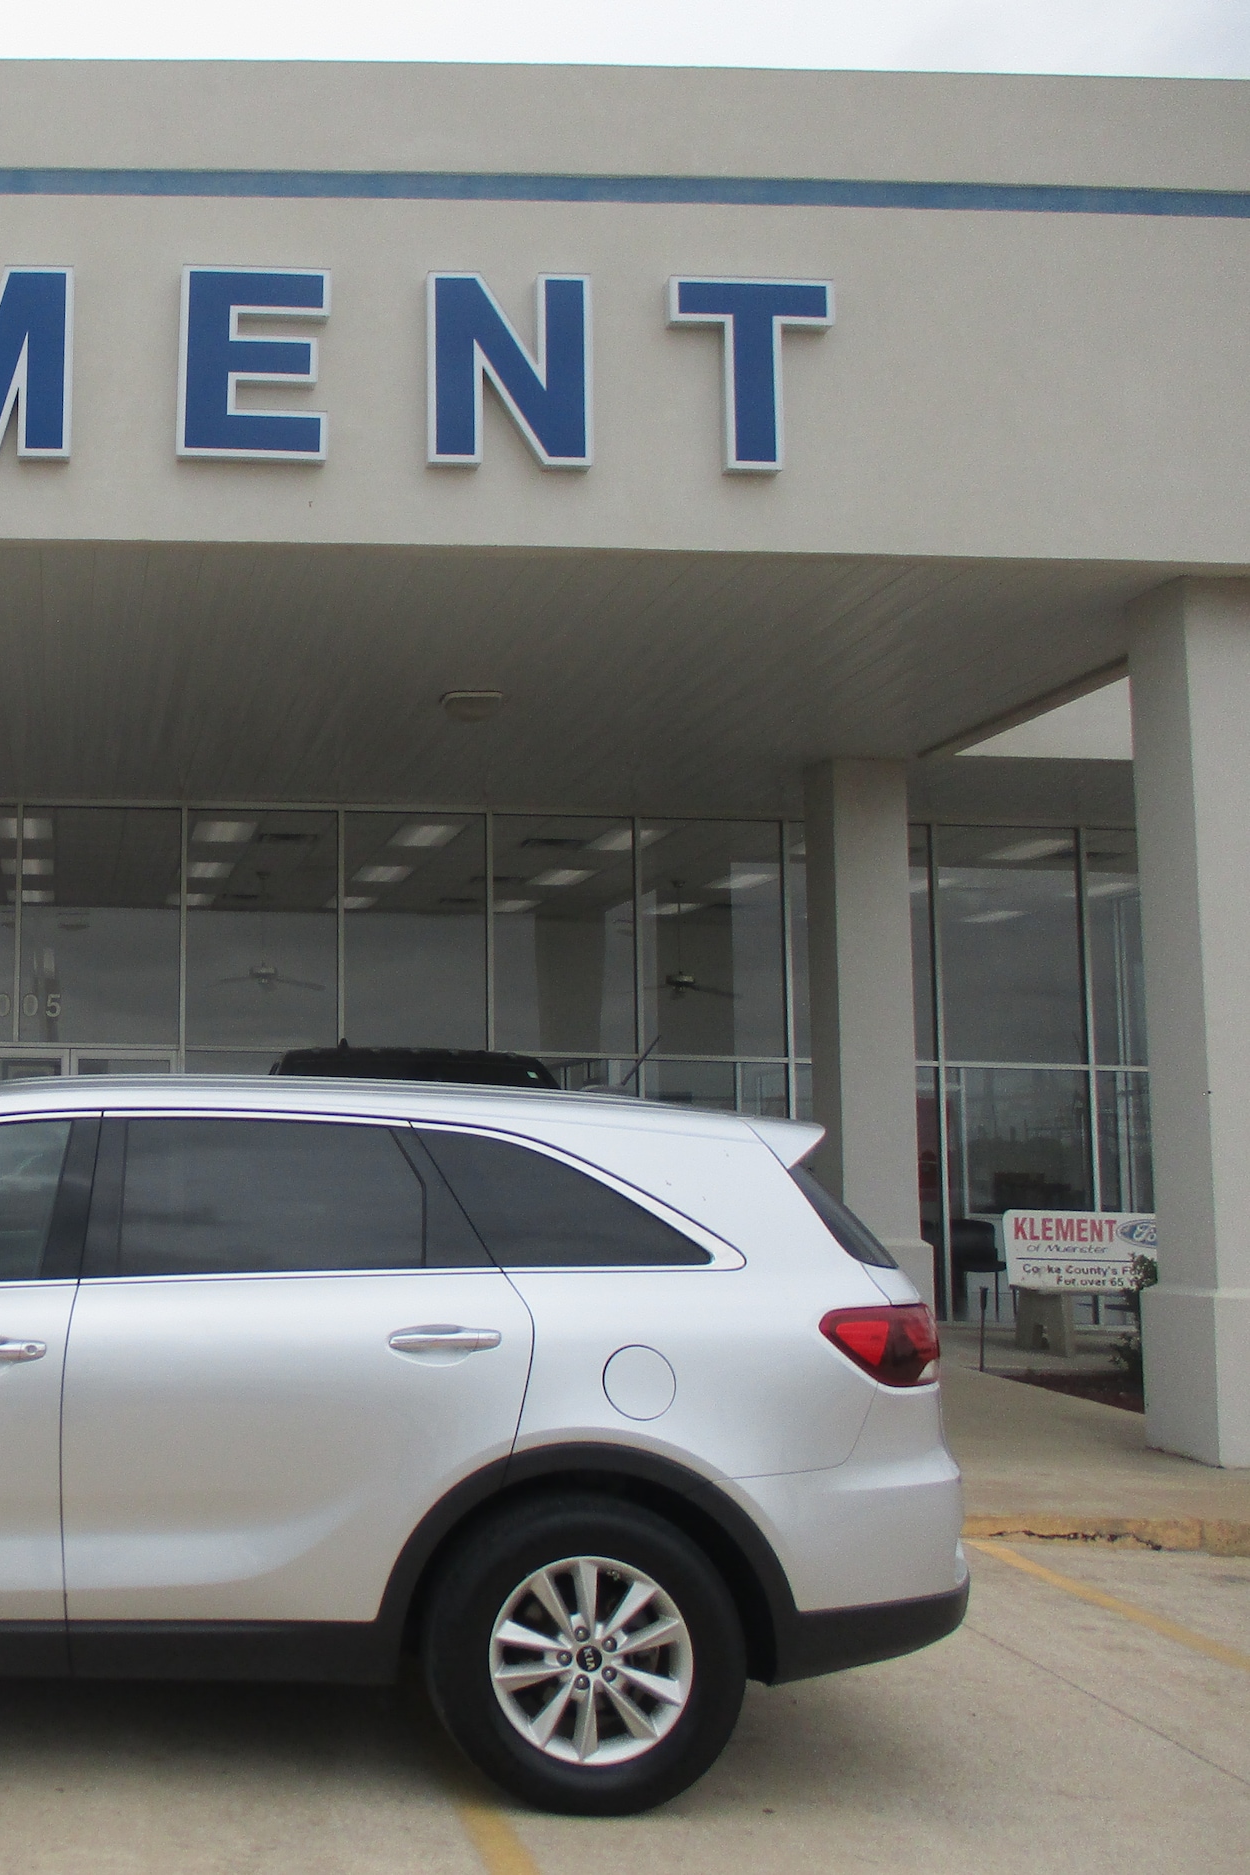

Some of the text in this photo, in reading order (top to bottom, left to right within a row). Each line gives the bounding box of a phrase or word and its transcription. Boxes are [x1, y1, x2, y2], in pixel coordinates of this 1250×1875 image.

[1013, 1216, 1118, 1243] KLEMENT
[1064, 1264, 1118, 1277] County's
[1079, 1279, 1106, 1287] over
[1109, 1277, 1124, 1287] 65
[583, 1648, 596, 1671] KIA
